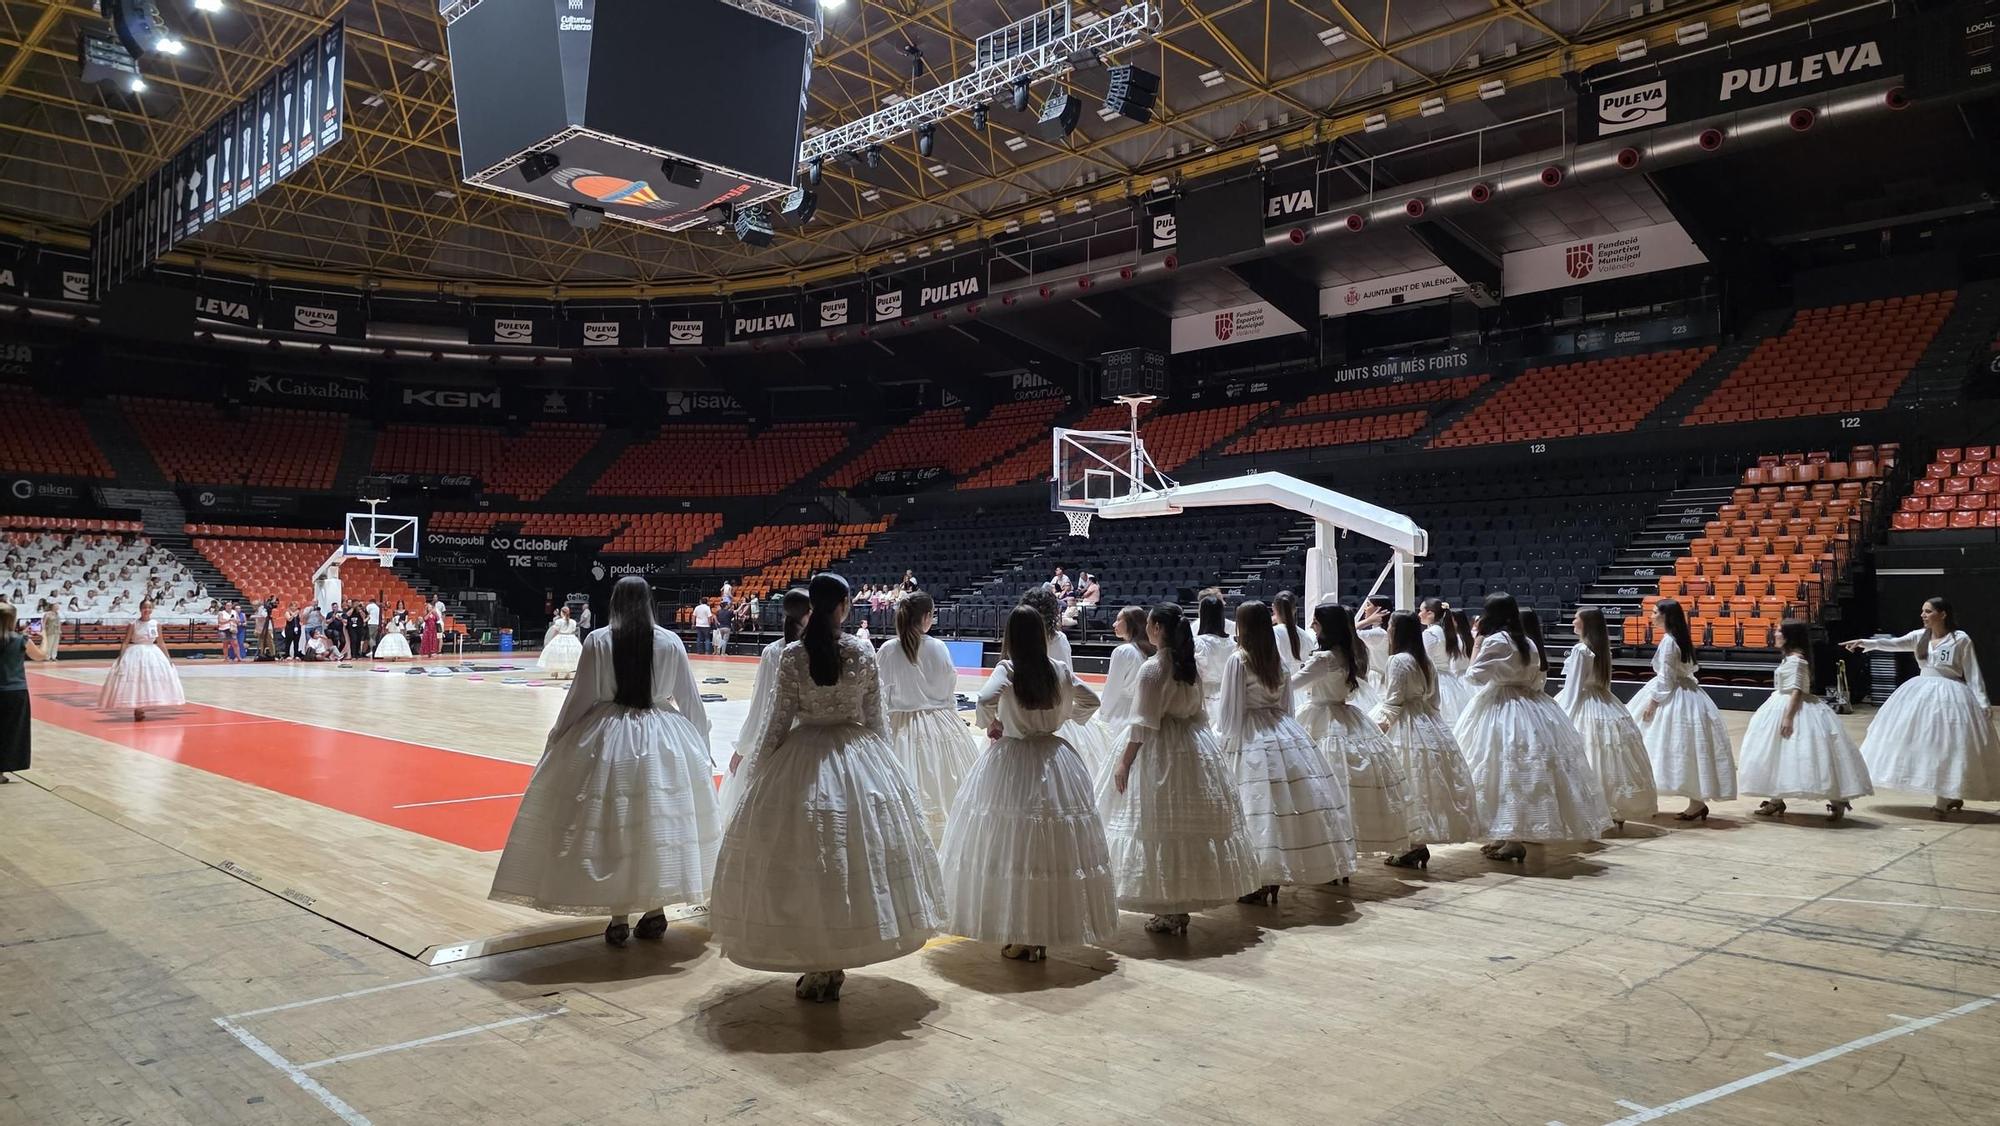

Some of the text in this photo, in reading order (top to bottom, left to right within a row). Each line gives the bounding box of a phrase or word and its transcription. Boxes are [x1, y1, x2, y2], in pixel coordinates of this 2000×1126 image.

[560, 15, 585, 24] Cultura
[560, 23, 592, 31] Esfuerzo
[1965, 20, 1996, 34] LOCAL
[1719, 40, 1883, 101] PULEVA
[1602, 88, 1663, 111] PULEVA
[1597, 236, 1638, 250] Fundació
[1597, 244, 1640, 258] Esportiva
[1597, 252, 1641, 266] Municipal
[920, 277, 980, 307] PULEVA
[1363, 285, 1408, 299] AJUNTAMENT
[1410, 283, 1420, 291] DE
[877, 295, 901, 306] PULEVA
[823, 303, 847, 312] PULEVA
[297, 308, 336, 321] PULEVA
[497, 322, 531, 331] PULEVA
[586, 325, 617, 333] PULEVA
[672, 324, 701, 332] PULEVA
[735, 312, 795, 336] PULEVA
[1672, 325, 1687, 335] 223
[1334, 352, 1468, 383] JUNTS SOM MÉS FORTS
[1392, 375, 1404, 383] 224
[276, 378, 369, 400] CaixaBank
[402, 388, 502, 408] KGM
[1839, 417, 1861, 428] 122
[1530, 444, 1545, 454] 123
[38, 484, 73, 496] aiken
[445, 536, 485, 547] mapubli
[513, 538, 568, 551] CicloBuff
[507, 555, 532, 567] TKE
[1940, 649, 1950, 662] 51
